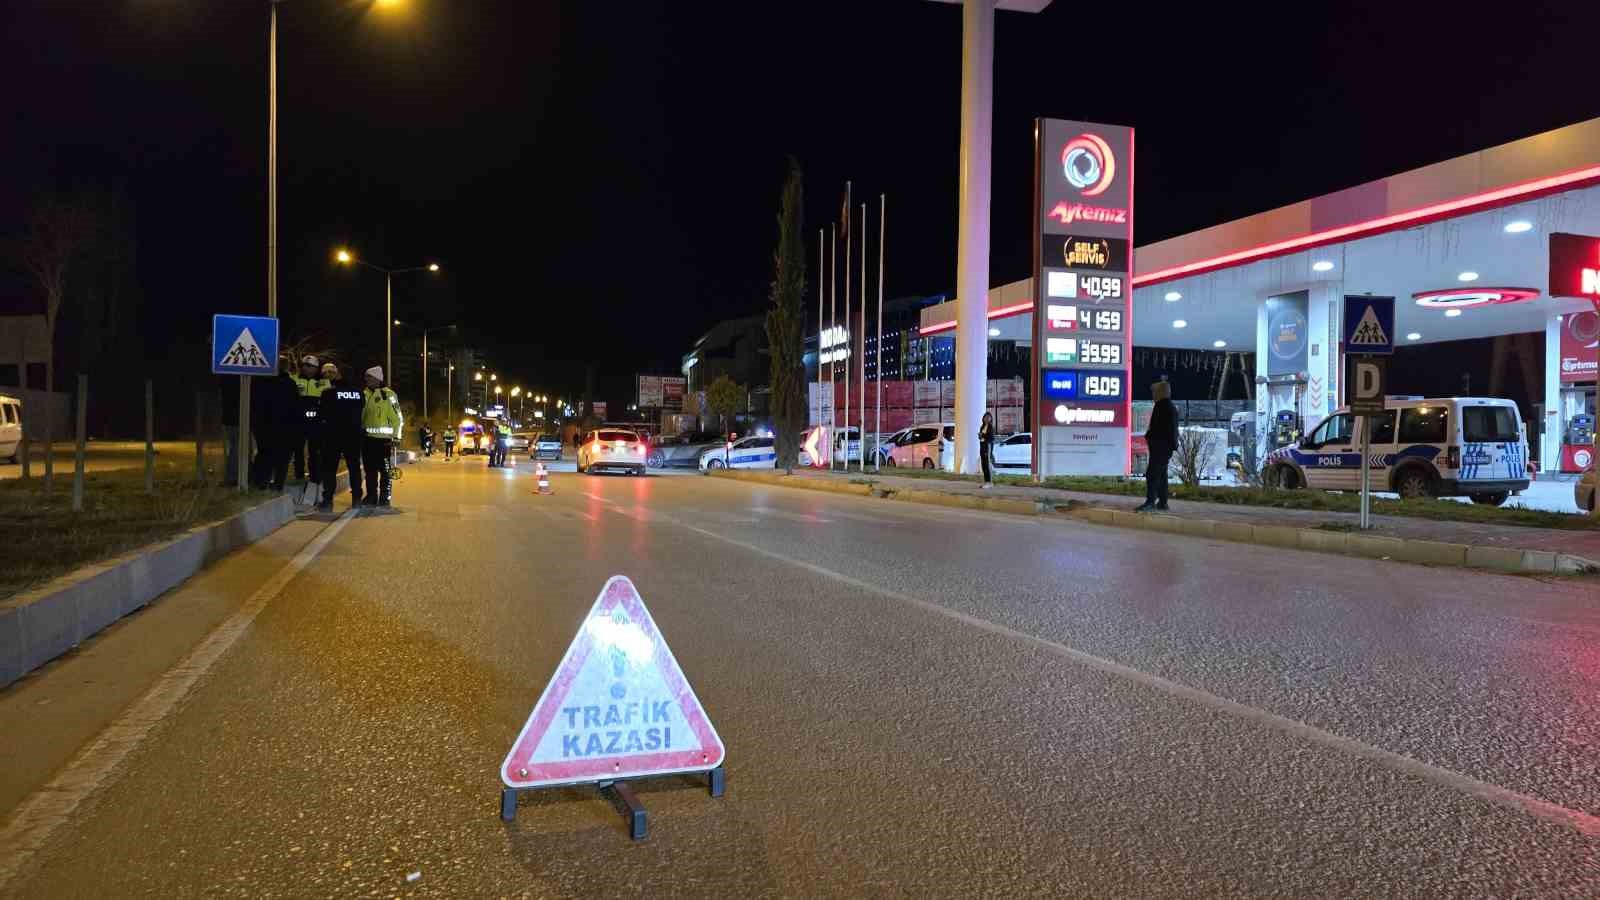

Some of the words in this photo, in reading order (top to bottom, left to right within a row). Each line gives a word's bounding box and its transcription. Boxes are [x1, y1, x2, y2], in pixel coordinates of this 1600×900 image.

[1562, 360, 1598, 371] Optimu
[1356, 363, 1380, 398] D
[562, 728, 671, 757] KAZASI
